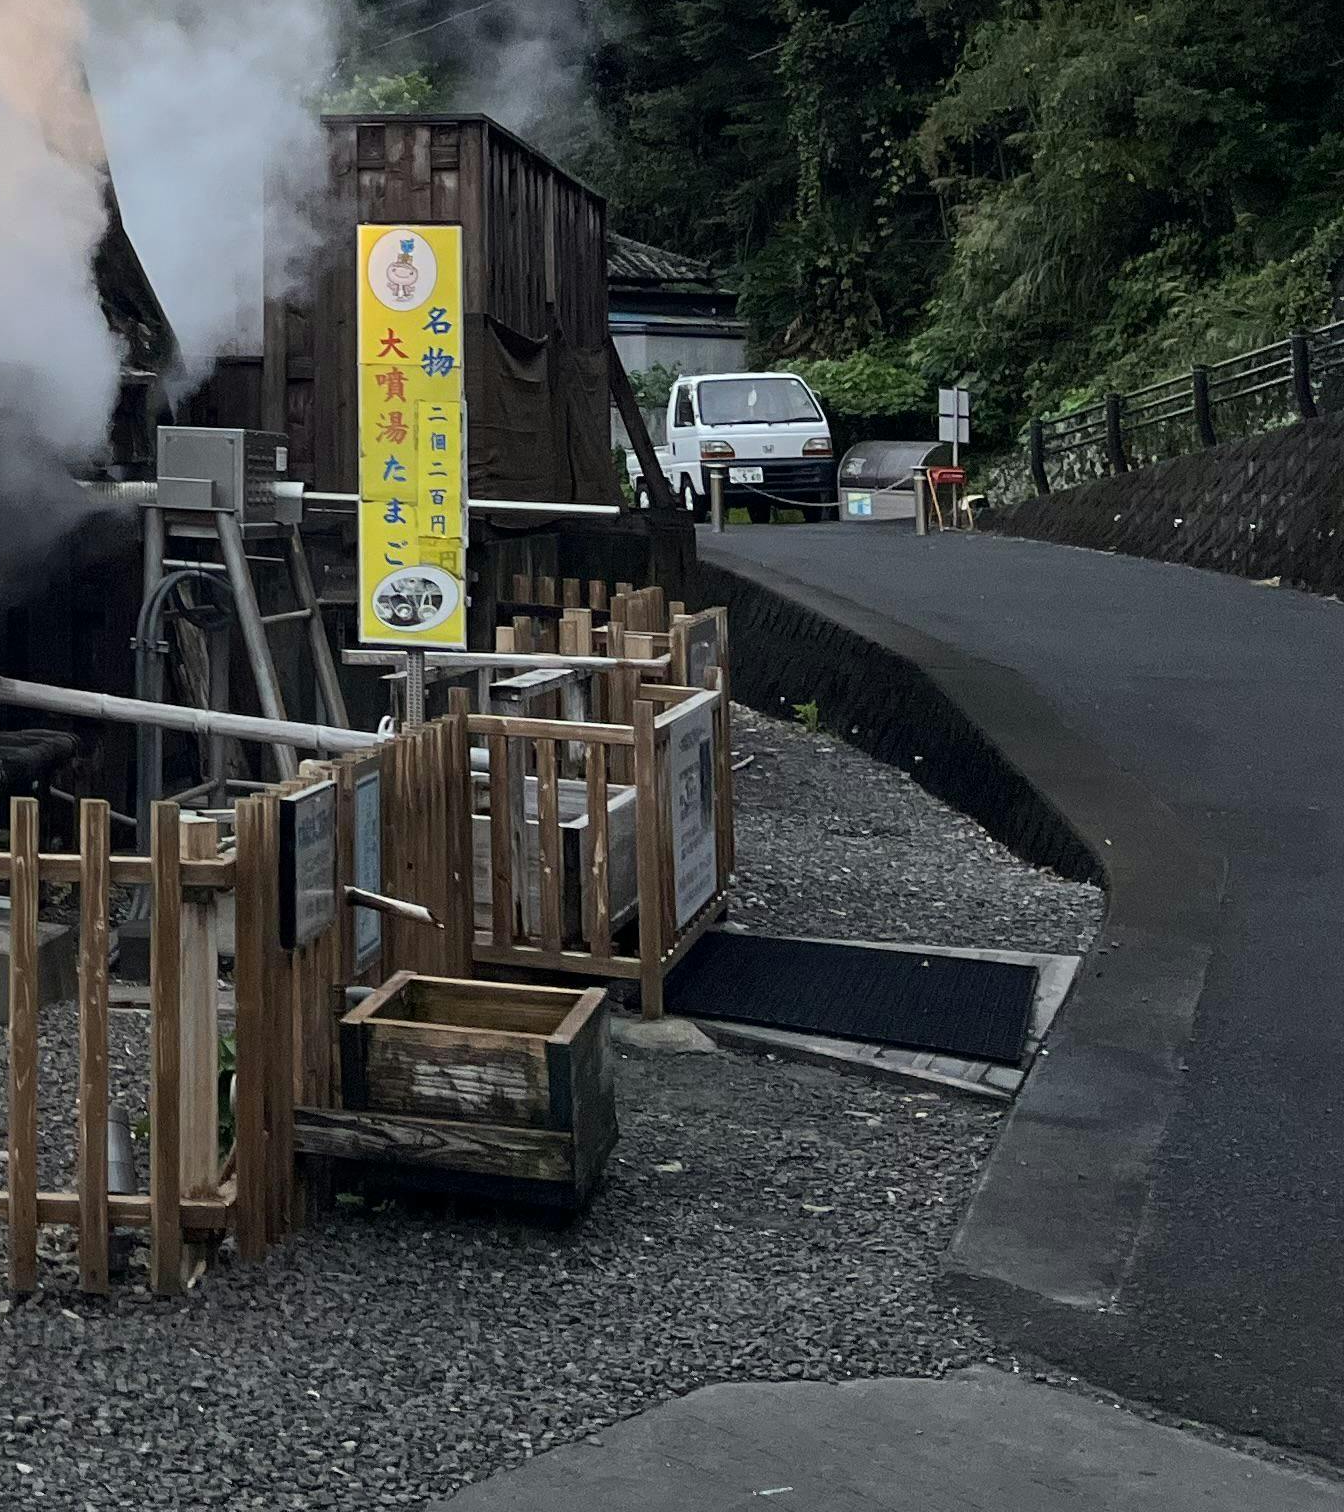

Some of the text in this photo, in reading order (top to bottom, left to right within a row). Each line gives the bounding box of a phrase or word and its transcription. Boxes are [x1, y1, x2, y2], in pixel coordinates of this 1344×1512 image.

[421, 307, 454, 377] 名物
[376, 328, 409, 567] 大噴湯たまご
